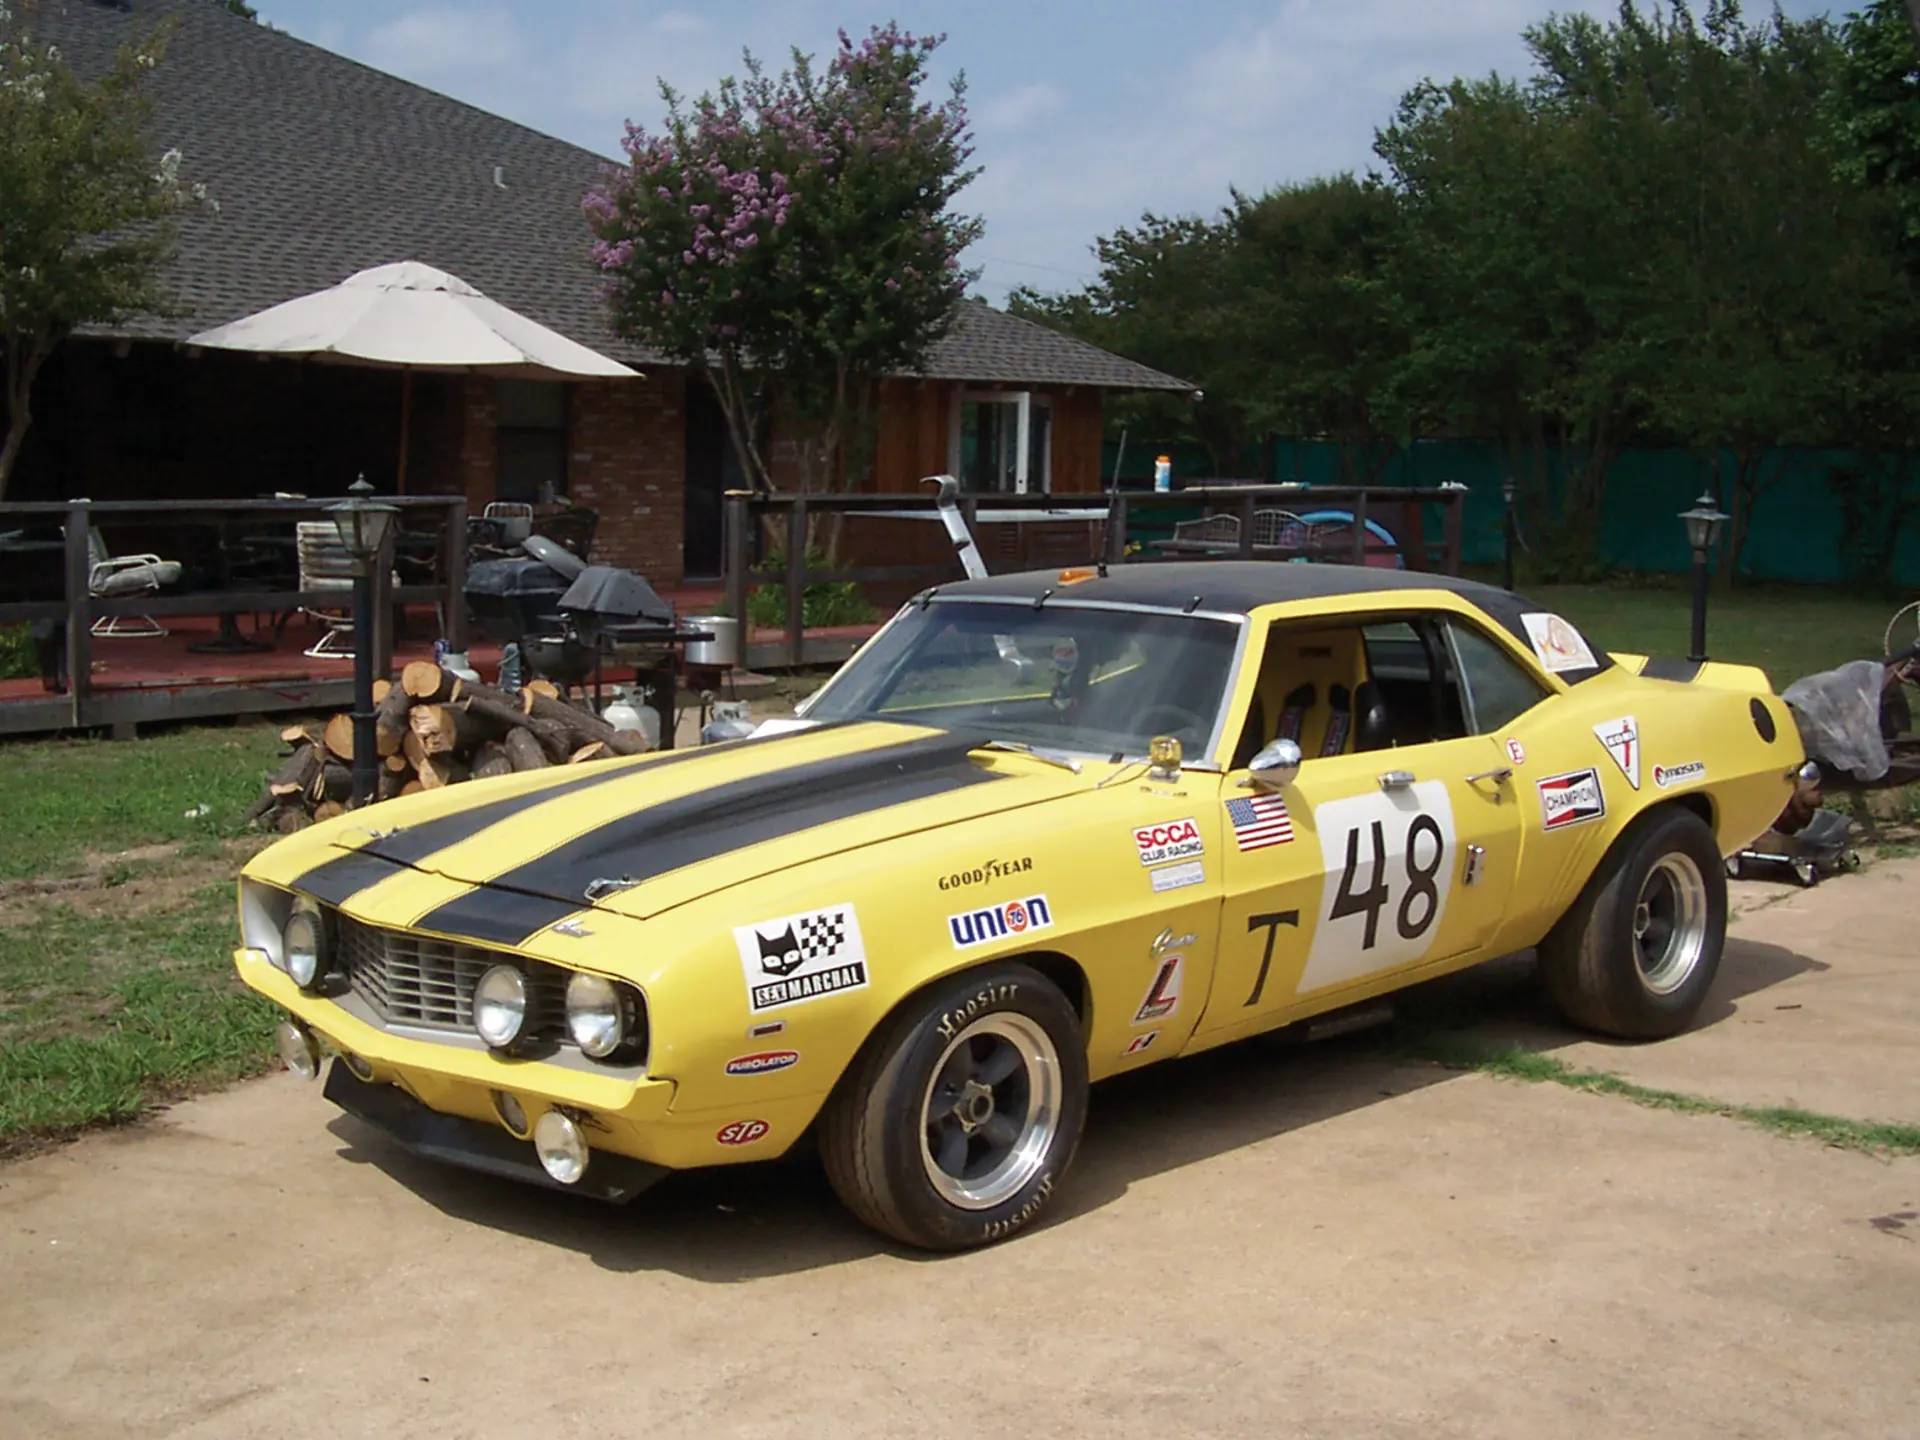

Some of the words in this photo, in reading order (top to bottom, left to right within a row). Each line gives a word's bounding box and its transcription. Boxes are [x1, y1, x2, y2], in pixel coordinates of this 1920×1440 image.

[1546, 786, 1596, 811] CHAMPION
[1136, 822, 1198, 849] SCCA
[1140, 848, 1166, 863] CLUB
[1167, 841, 1204, 857] RACING
[1329, 814, 1443, 950] 48
[1243, 909, 1299, 1007] T
[788, 966, 860, 999] MARCHAL
[937, 982, 1018, 1040] Hoosier
[722, 1121, 765, 1142] STP
